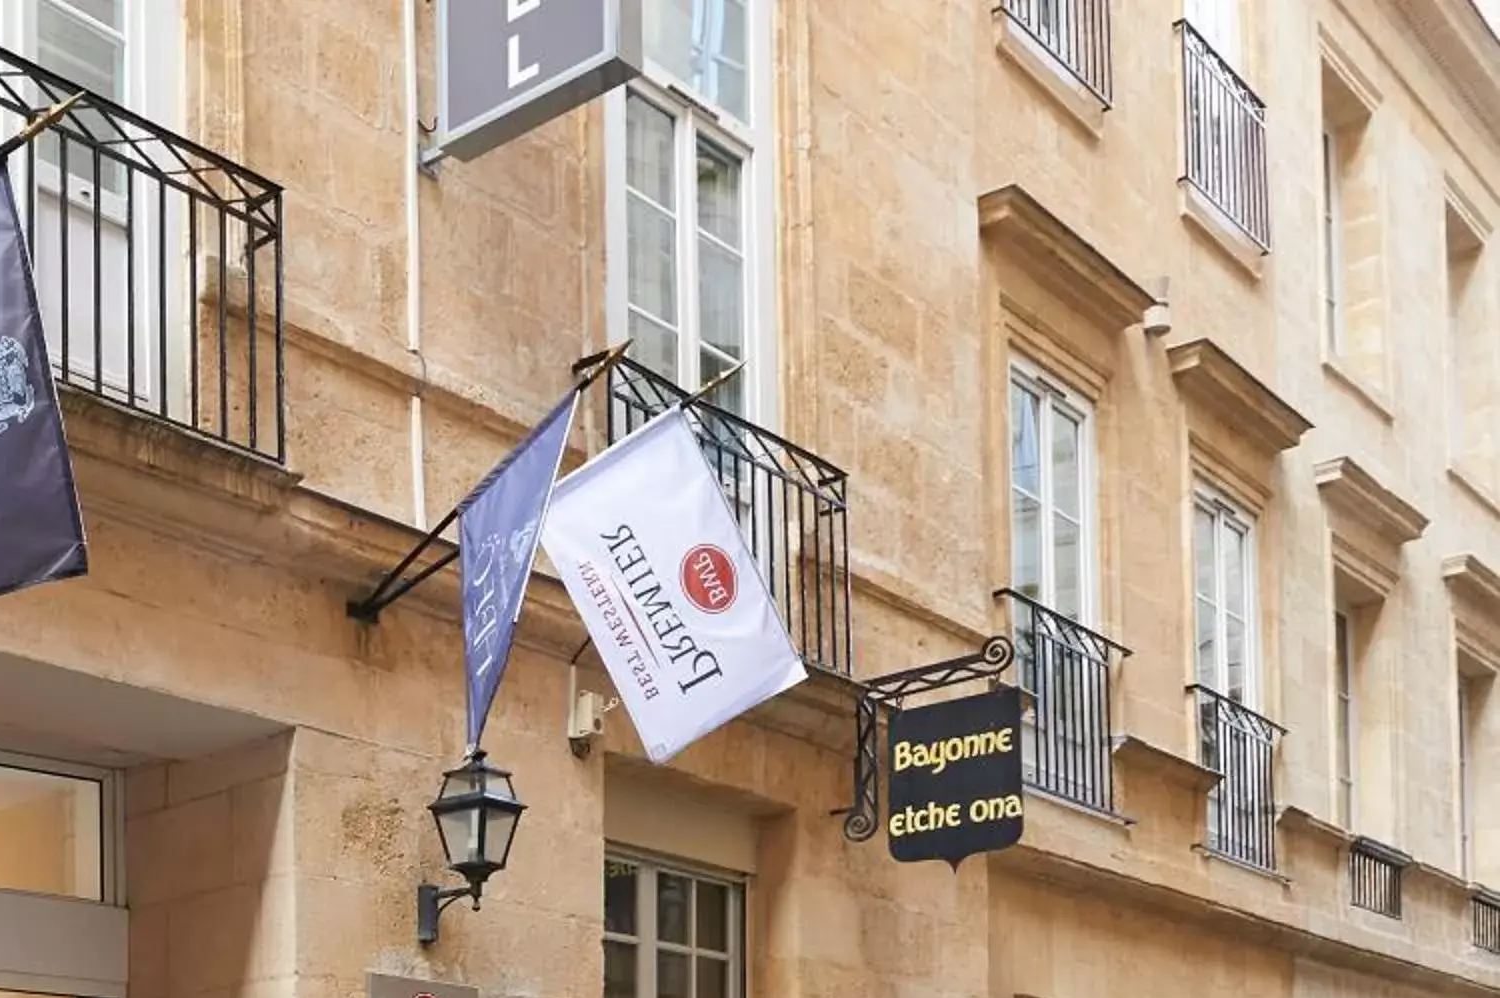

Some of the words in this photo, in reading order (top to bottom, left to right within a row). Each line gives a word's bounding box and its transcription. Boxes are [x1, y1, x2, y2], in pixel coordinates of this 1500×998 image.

[894, 727, 1013, 775] Bayonne
[889, 801, 962, 838] etche
[969, 794, 1024, 823] ona
